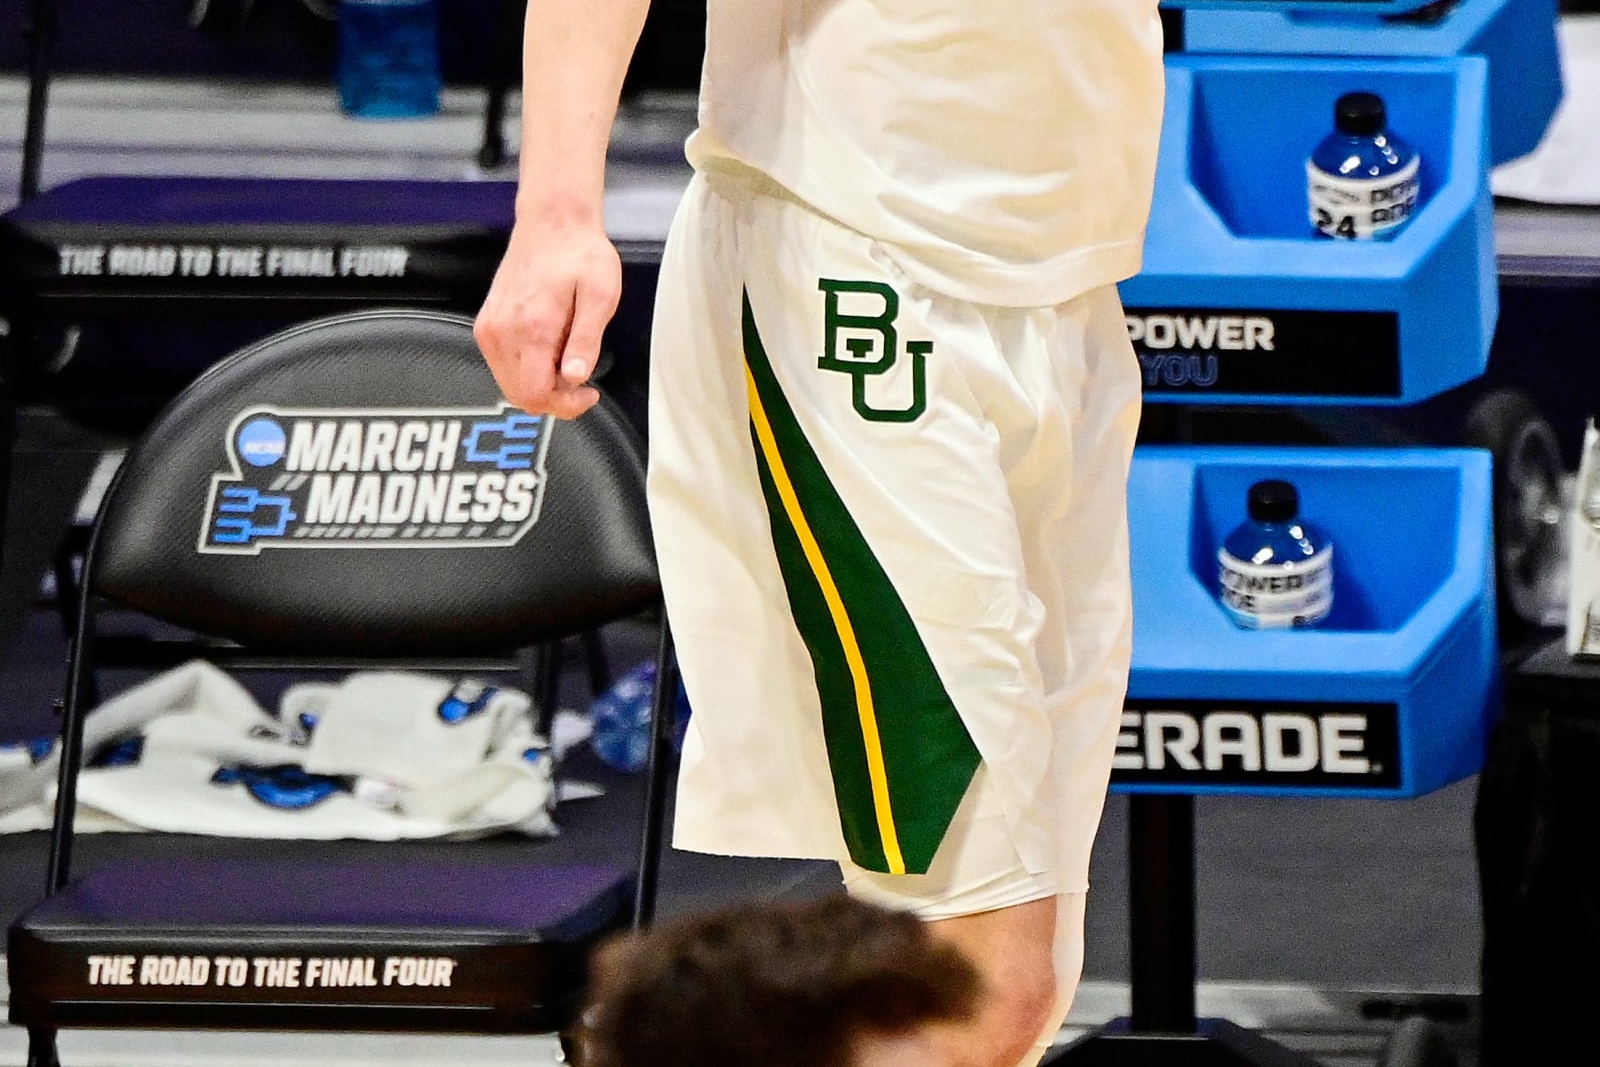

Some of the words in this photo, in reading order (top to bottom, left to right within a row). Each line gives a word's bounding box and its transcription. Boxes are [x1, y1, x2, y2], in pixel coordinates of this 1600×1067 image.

[60, 246, 105, 276] THE
[108, 246, 177, 276] ROAD
[179, 246, 213, 276] TO
[216, 246, 263, 276] THE
[265, 246, 336, 276] FINAL
[339, 246, 409, 276] FOUR
[818, 278, 933, 422] BU
[1126, 315, 1275, 351] POWER
[285, 420, 462, 472] MARCH
[304, 471, 536, 524] MADNESS
[87, 955, 136, 986] THE
[139, 955, 211, 986] ROAD
[214, 955, 248, 986] TO
[253, 955, 301, 986] THE
[305, 955, 378, 986] FINAL
[382, 955, 454, 986] FOUR
